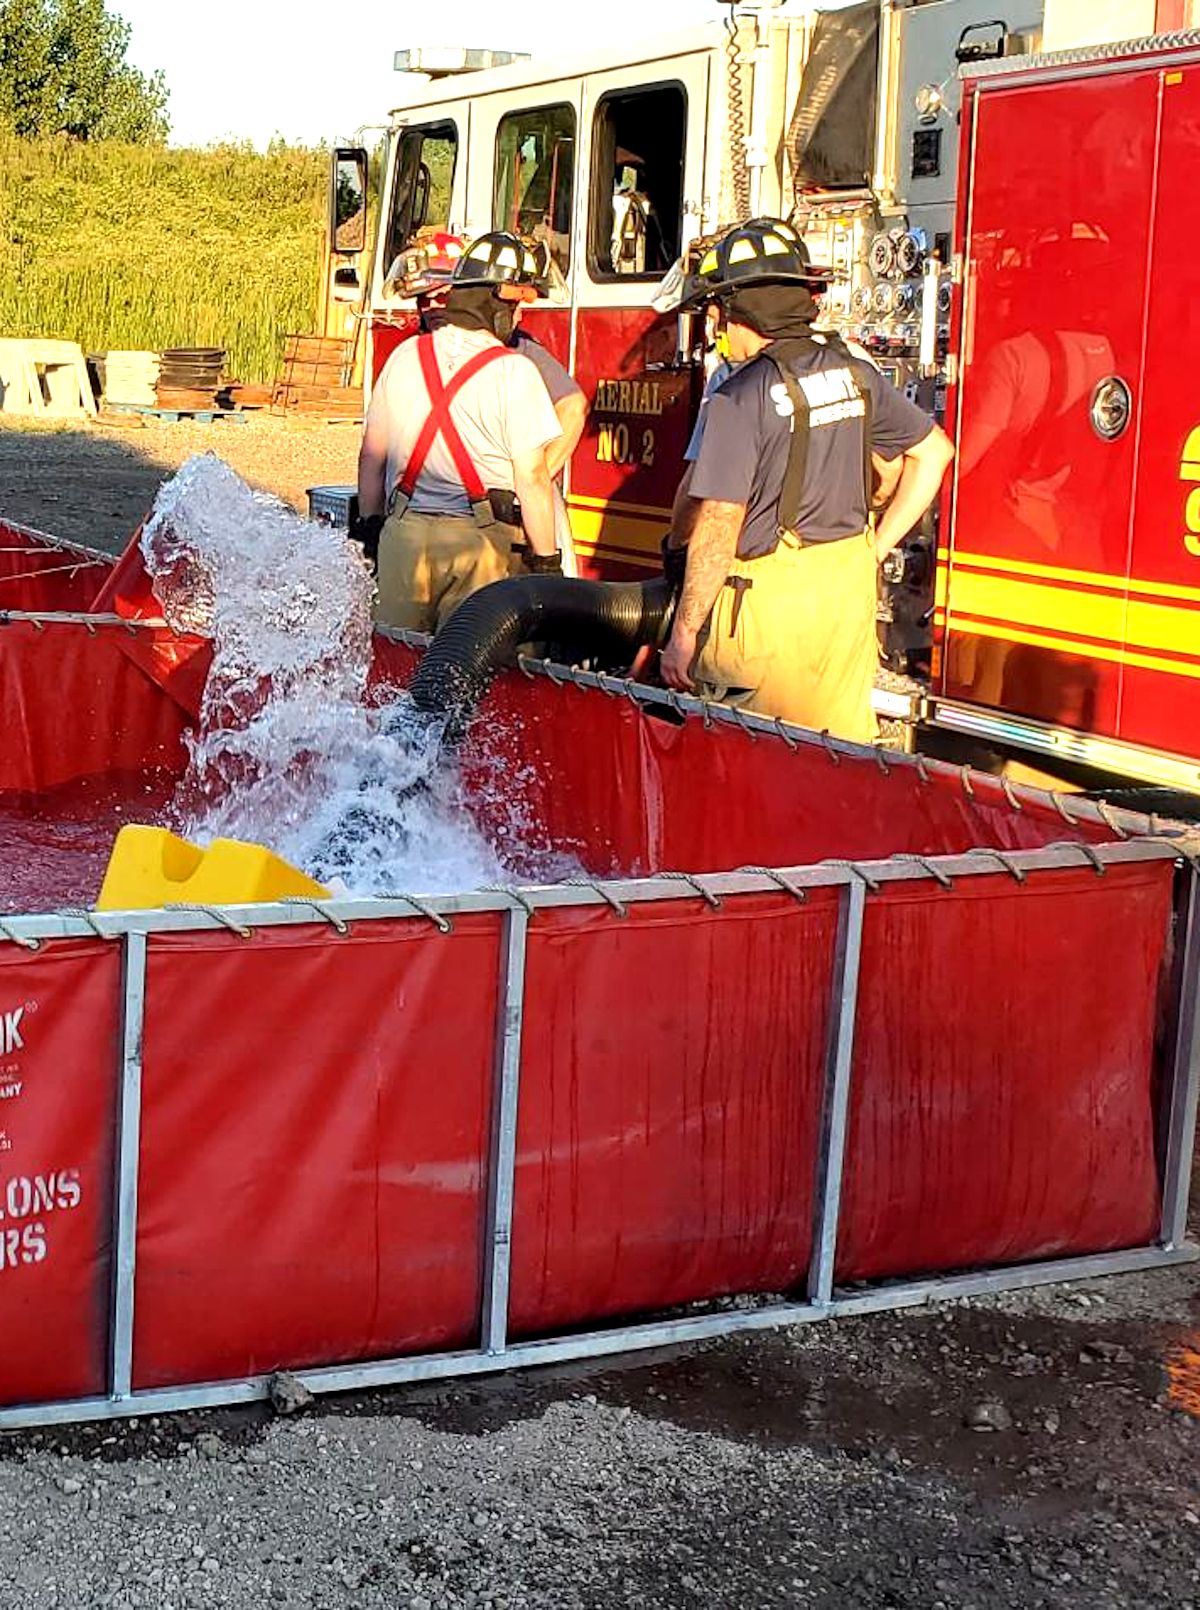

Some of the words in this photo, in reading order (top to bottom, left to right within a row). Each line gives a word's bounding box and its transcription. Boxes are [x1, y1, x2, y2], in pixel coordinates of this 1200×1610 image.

[594, 379, 662, 415] AERIAL
[597, 423, 633, 463] NO.
[641, 429, 655, 466] 2
